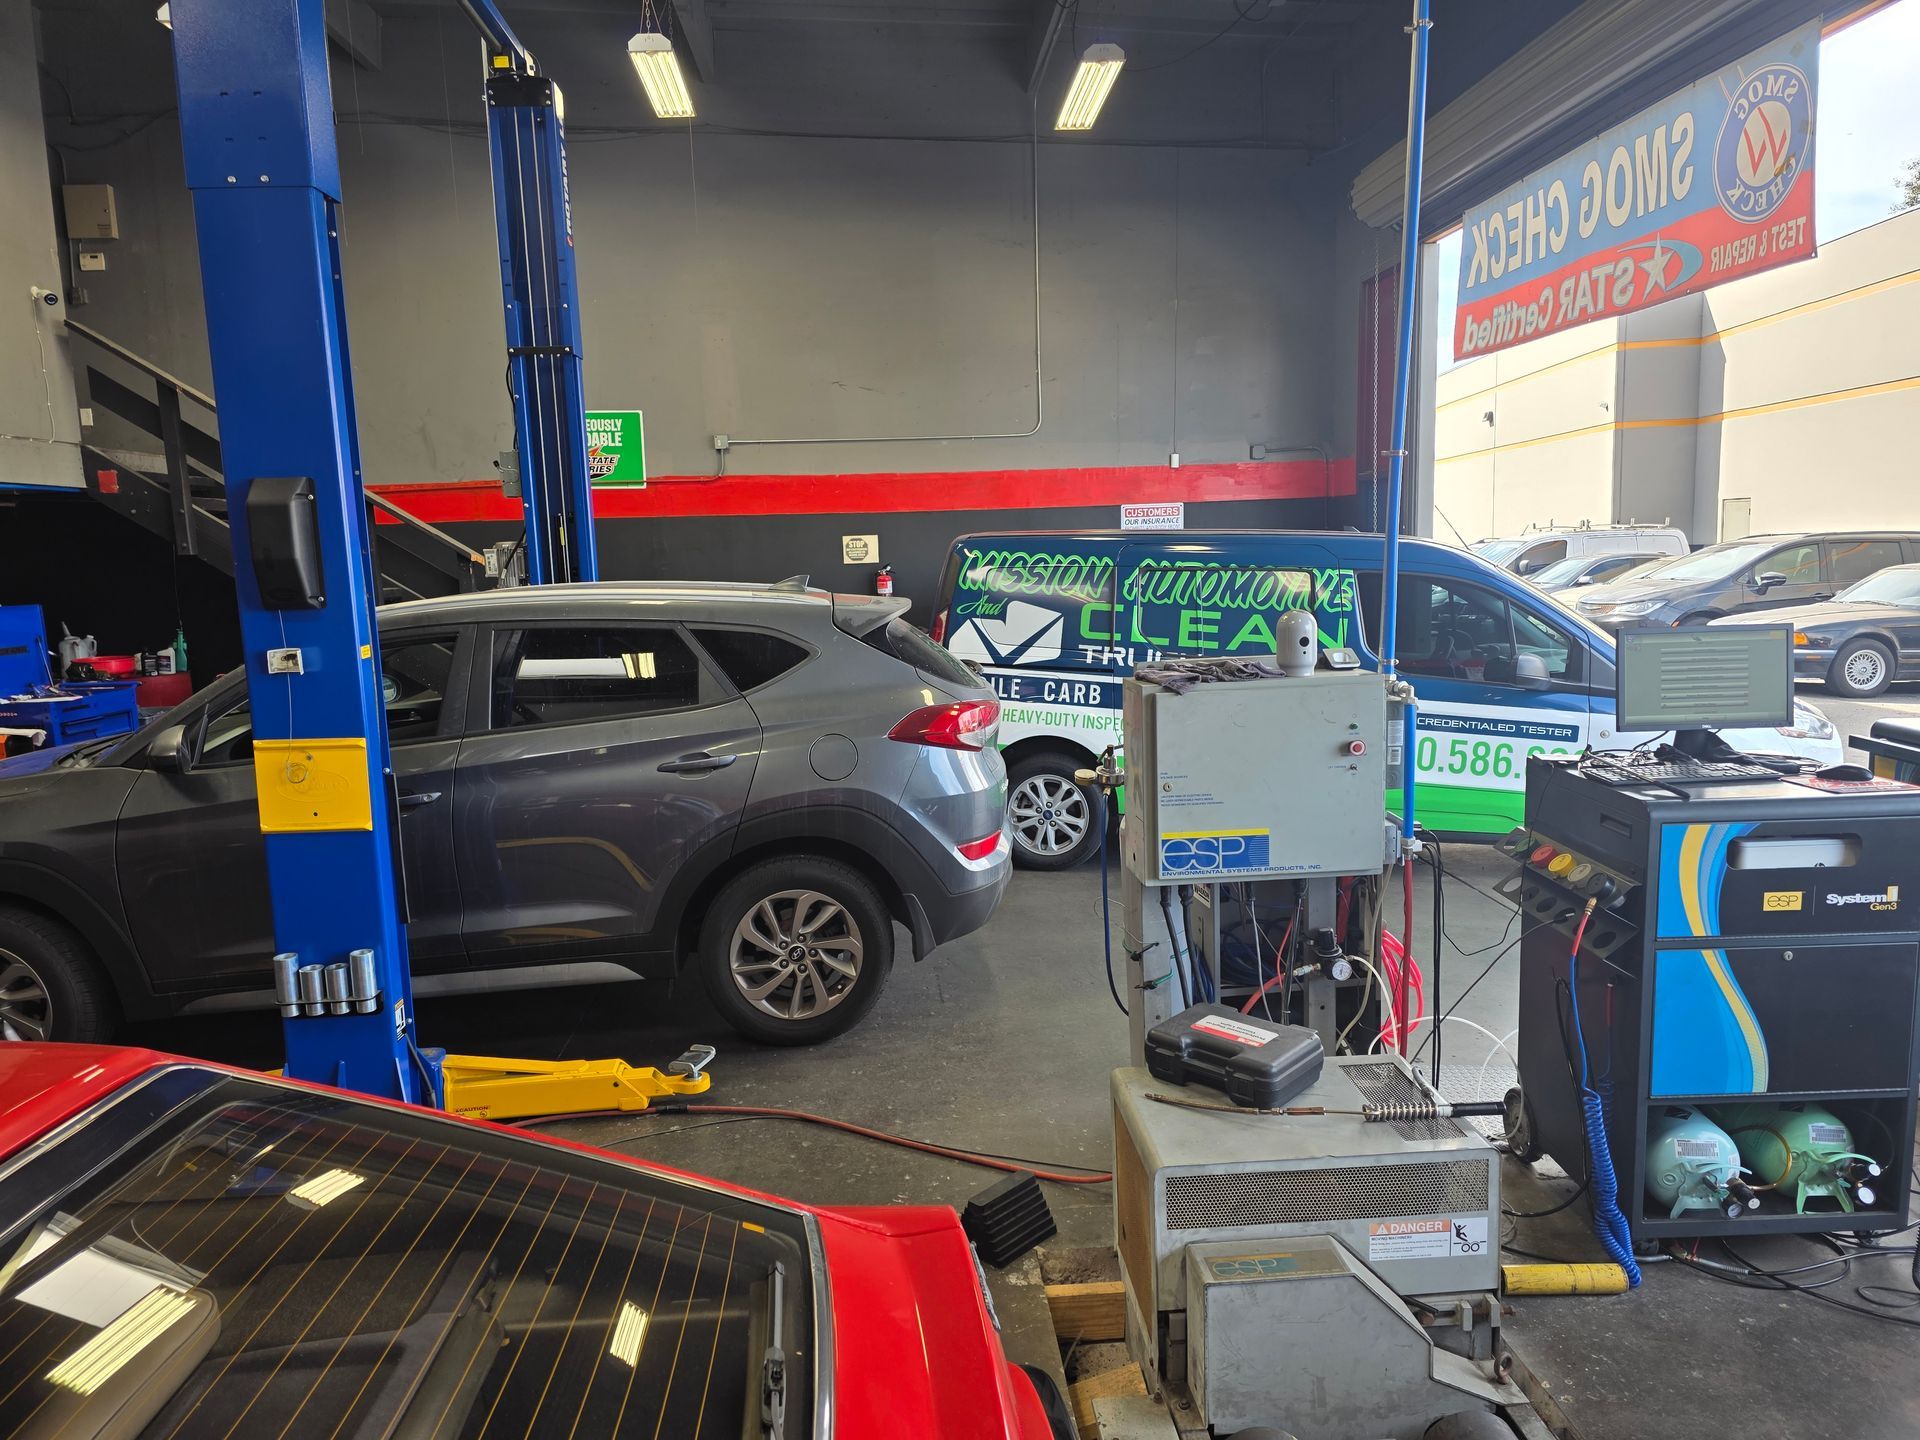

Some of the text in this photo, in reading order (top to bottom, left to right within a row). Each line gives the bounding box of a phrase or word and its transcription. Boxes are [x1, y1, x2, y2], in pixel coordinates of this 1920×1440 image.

[586, 418, 623, 431] EOUSLY
[586, 431, 623, 447] DABLE
[589, 456, 616, 464] TATE
[589, 465, 612, 473] RIES
[1126, 507, 1179, 516] CUSTOMERS
[1140, 517, 1180, 525] INSURANCE
[848, 540, 865, 548] STOP
[958, 549, 1354, 614] MISSION AUTOMOTIVE
[956, 594, 1009, 616] And
[1079, 602, 1348, 654] CLEAN
[991, 676, 1101, 705] ILE CARB
[1002, 708, 1080, 727] HEAVY-DUTY
[1417, 716, 1516, 733] CREDENTIALED
[1520, 724, 1573, 737] TESTER
[1161, 868, 1225, 877] ENVIRONMENTAL
[1227, 866, 1263, 874] SYSTEMS
[1263, 864, 1307, 873] PRODUCTS,
[1869, 902, 1898, 911] Gen3
[1390, 1221, 1443, 1234] DANGER
